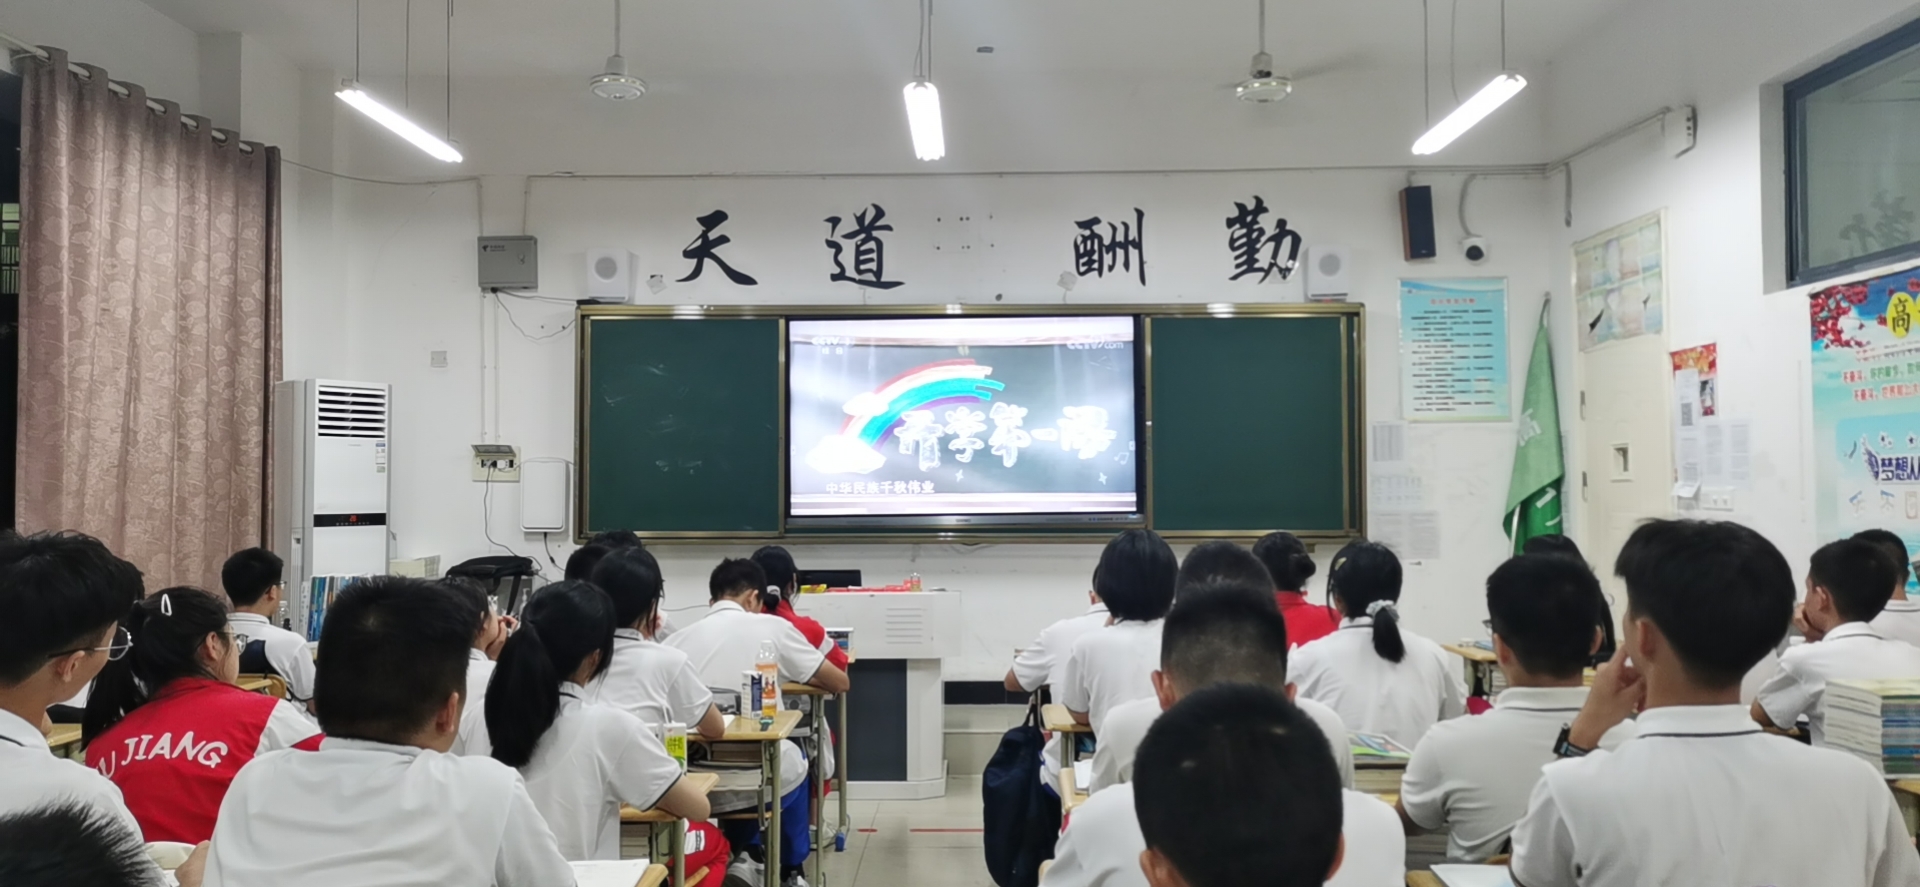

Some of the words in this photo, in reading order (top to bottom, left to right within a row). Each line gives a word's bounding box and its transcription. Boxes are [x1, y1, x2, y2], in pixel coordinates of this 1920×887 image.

[1892, 297, 1910, 334] 高
[894, 401, 1117, 471] 开学第一课
[825, 480, 935, 495] 中华民族千秋伟业
[121, 731, 229, 769] JIANG
